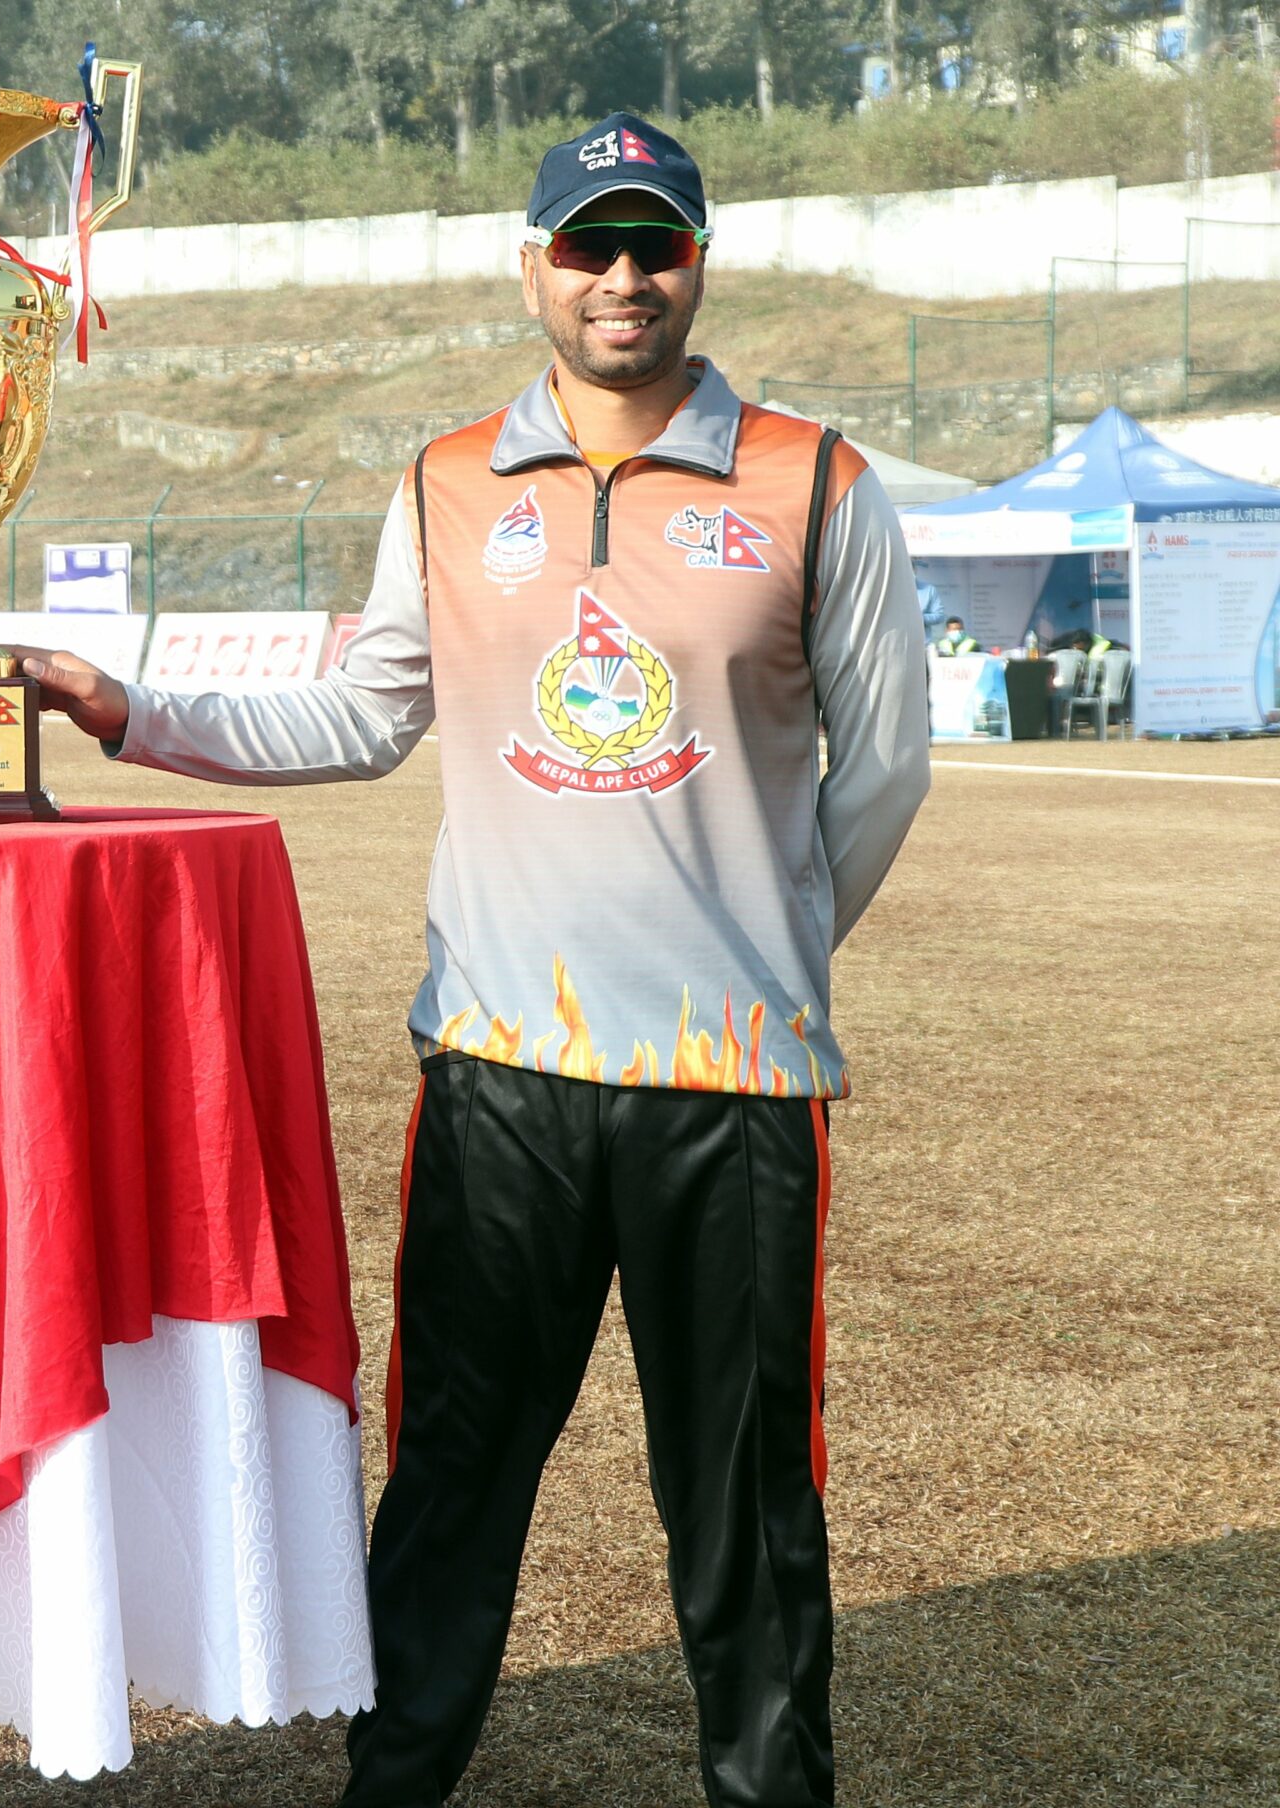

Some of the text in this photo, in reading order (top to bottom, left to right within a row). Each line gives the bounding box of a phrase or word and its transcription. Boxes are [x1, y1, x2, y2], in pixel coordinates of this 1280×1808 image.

[586, 156, 616, 171] CAN
[1164, 535, 1189, 546] HAMS
[688, 554, 718, 565] CAN
[538, 758, 670, 788] NEPAL APF CLUB
